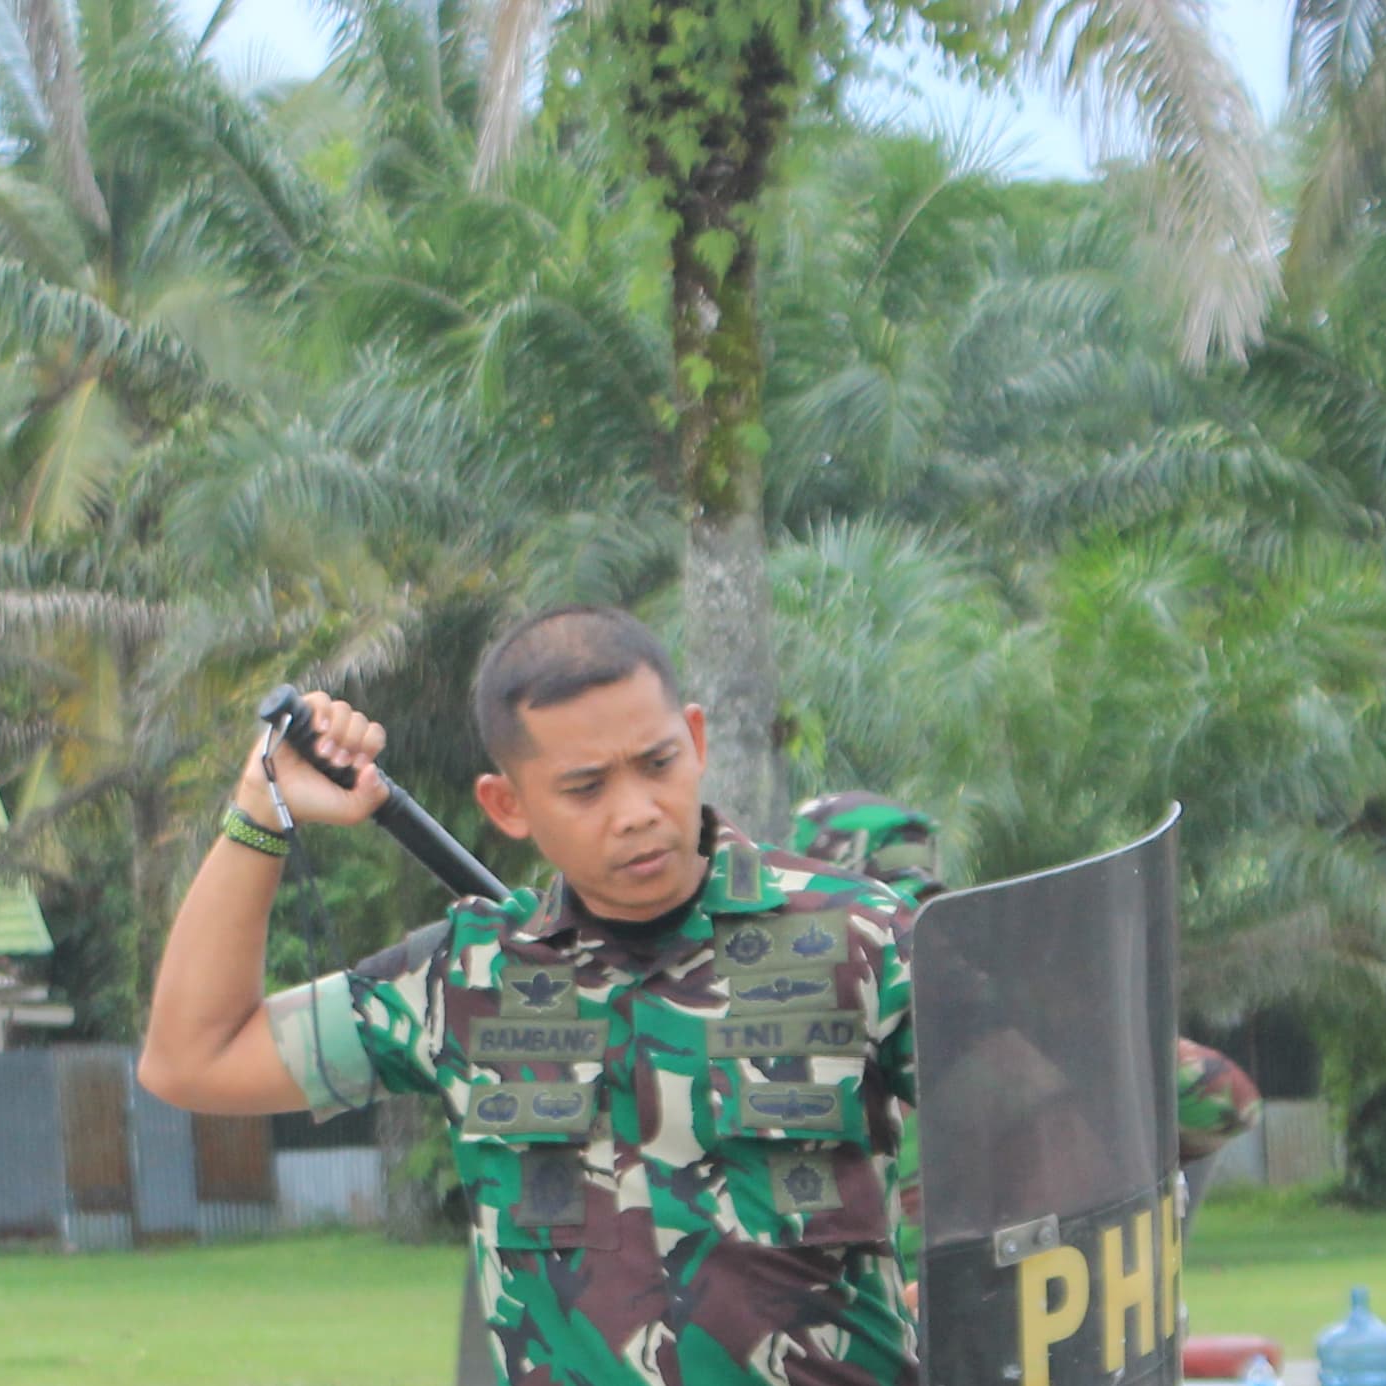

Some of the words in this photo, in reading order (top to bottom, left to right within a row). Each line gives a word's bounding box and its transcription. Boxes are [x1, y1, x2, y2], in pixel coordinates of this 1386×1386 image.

[479, 1026, 597, 1052] BAMBANG
[717, 1023, 783, 1048] TNI
[805, 1020, 854, 1045] AD
